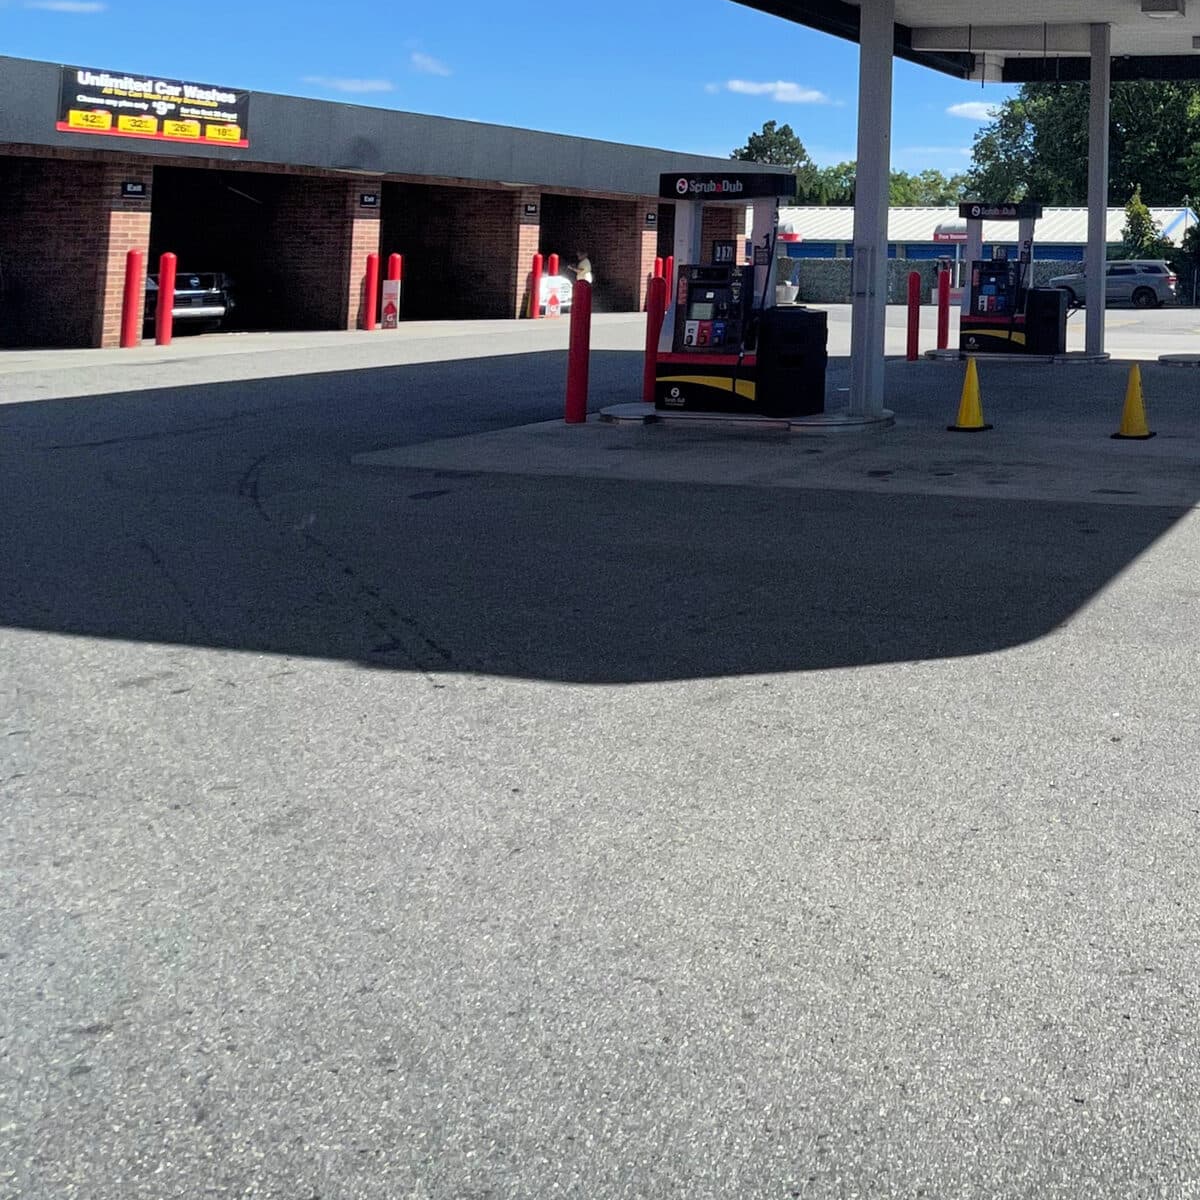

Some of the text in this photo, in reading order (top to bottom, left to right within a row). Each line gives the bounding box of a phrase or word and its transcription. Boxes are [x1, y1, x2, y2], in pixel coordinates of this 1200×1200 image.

[77, 70, 151, 94] Unlimited
[155, 81, 182, 97] Car
[184, 84, 237, 104] Washes
[126, 183, 142, 192] Exit
